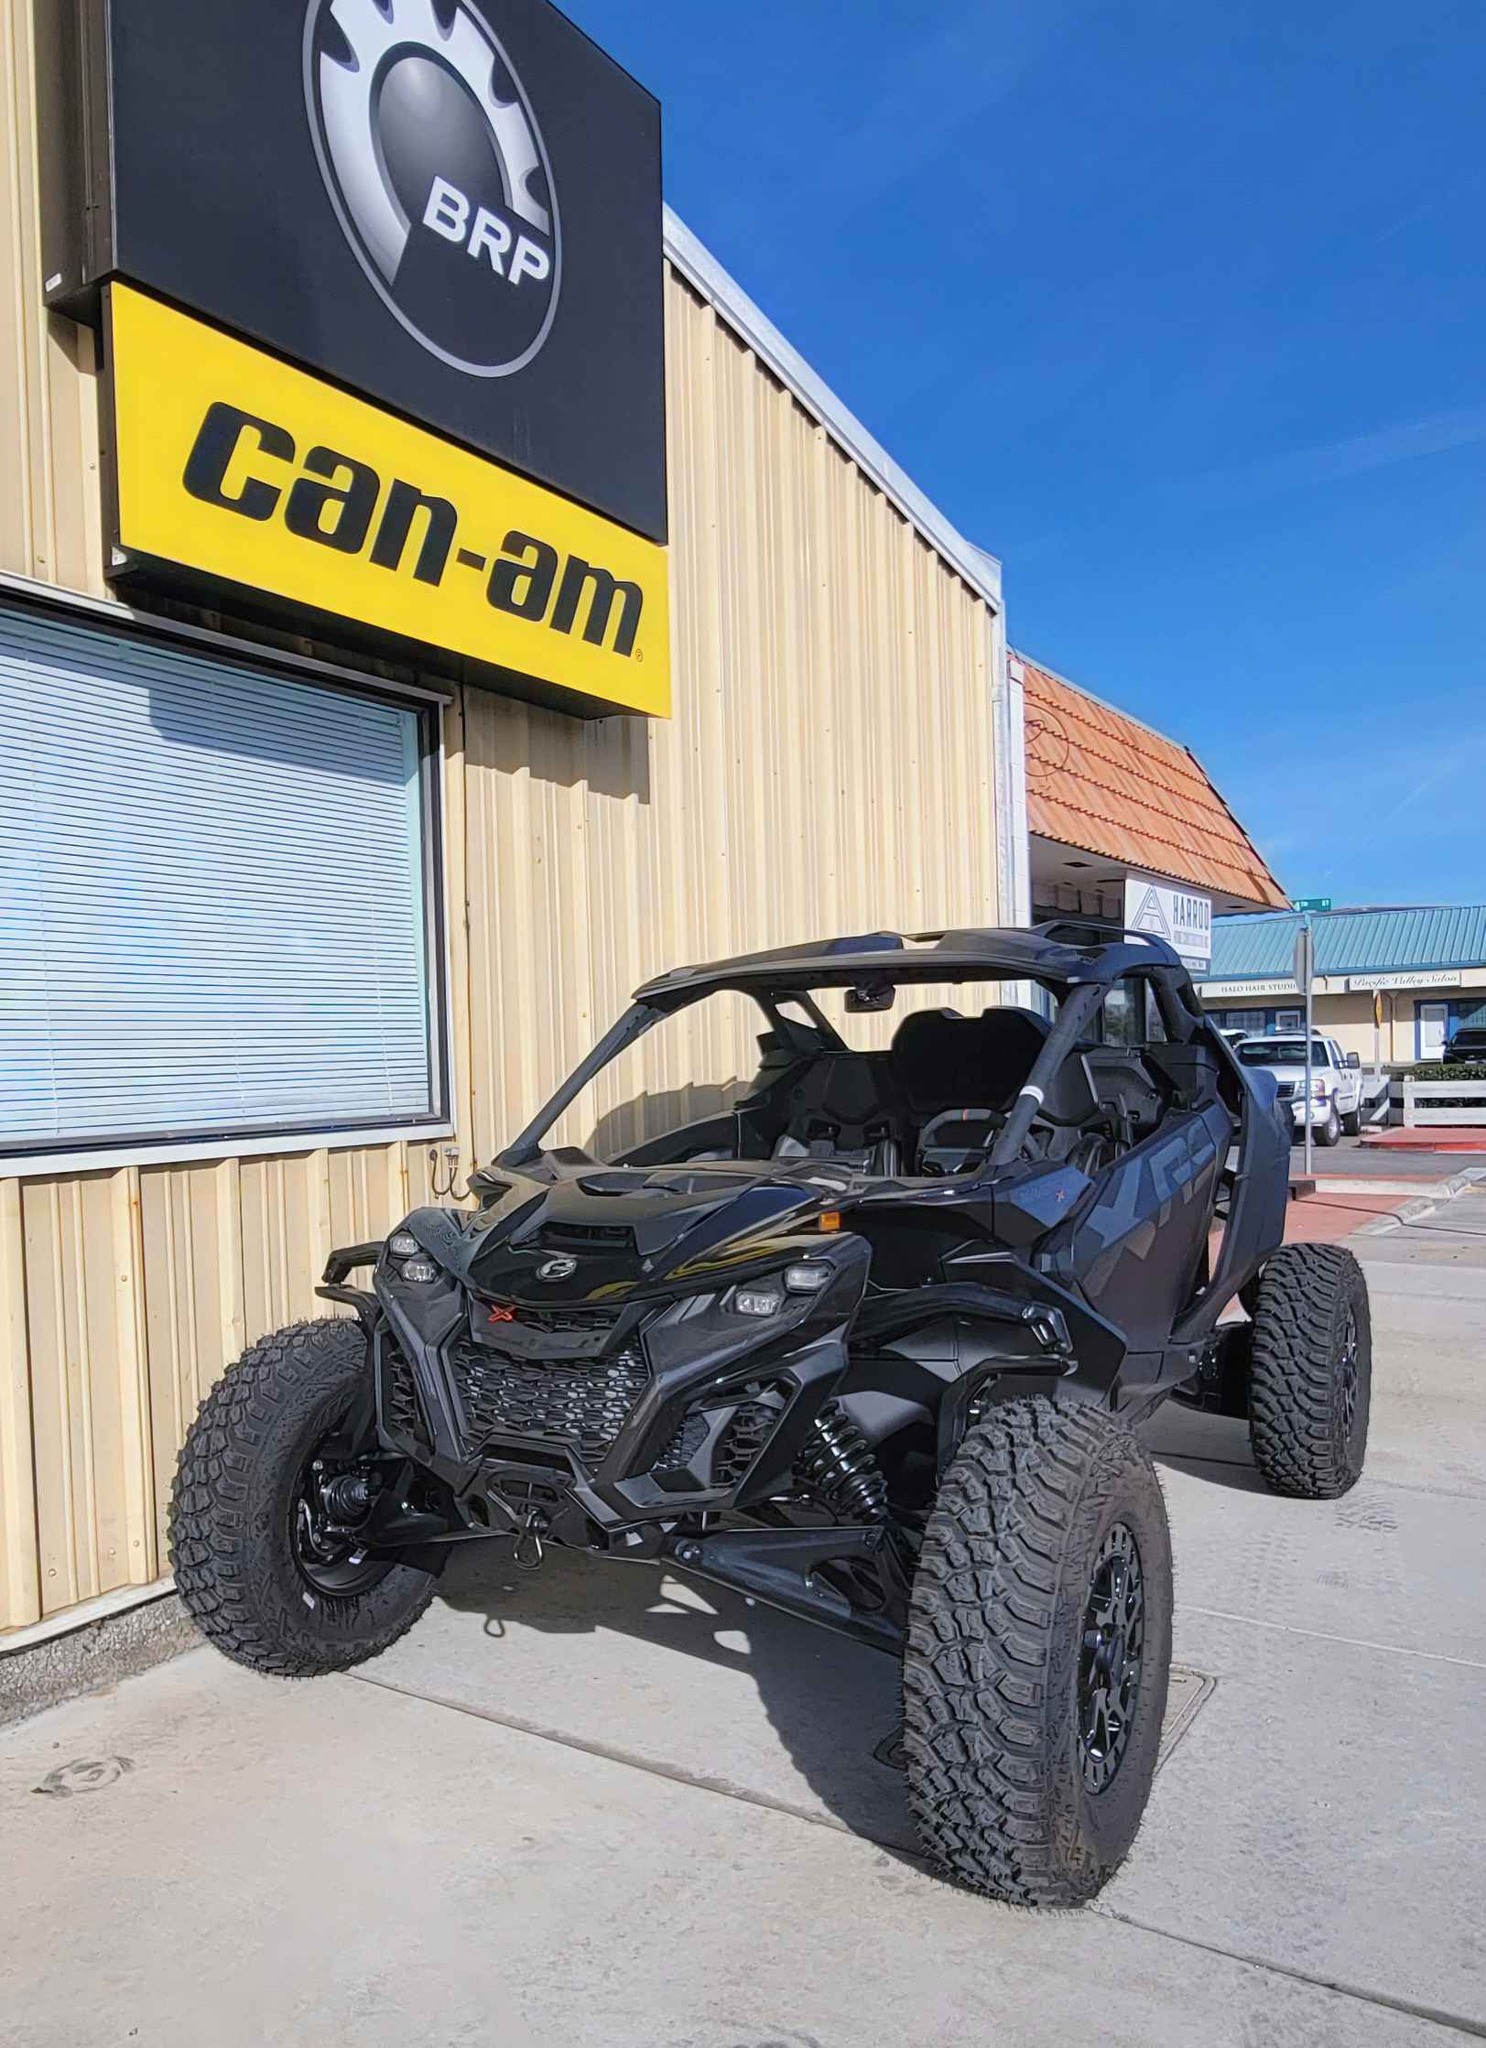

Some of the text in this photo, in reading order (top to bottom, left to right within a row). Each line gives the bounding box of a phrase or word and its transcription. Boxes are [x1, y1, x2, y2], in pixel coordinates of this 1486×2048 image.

[422, 175, 549, 286] BRP
[182, 401, 643, 658] can-am
[1221, 985, 1244, 993] HALO
[1245, 984, 1266, 992] HAIR
[1391, 975, 1424, 986] Valley
[1426, 973, 1458, 984] Salon
